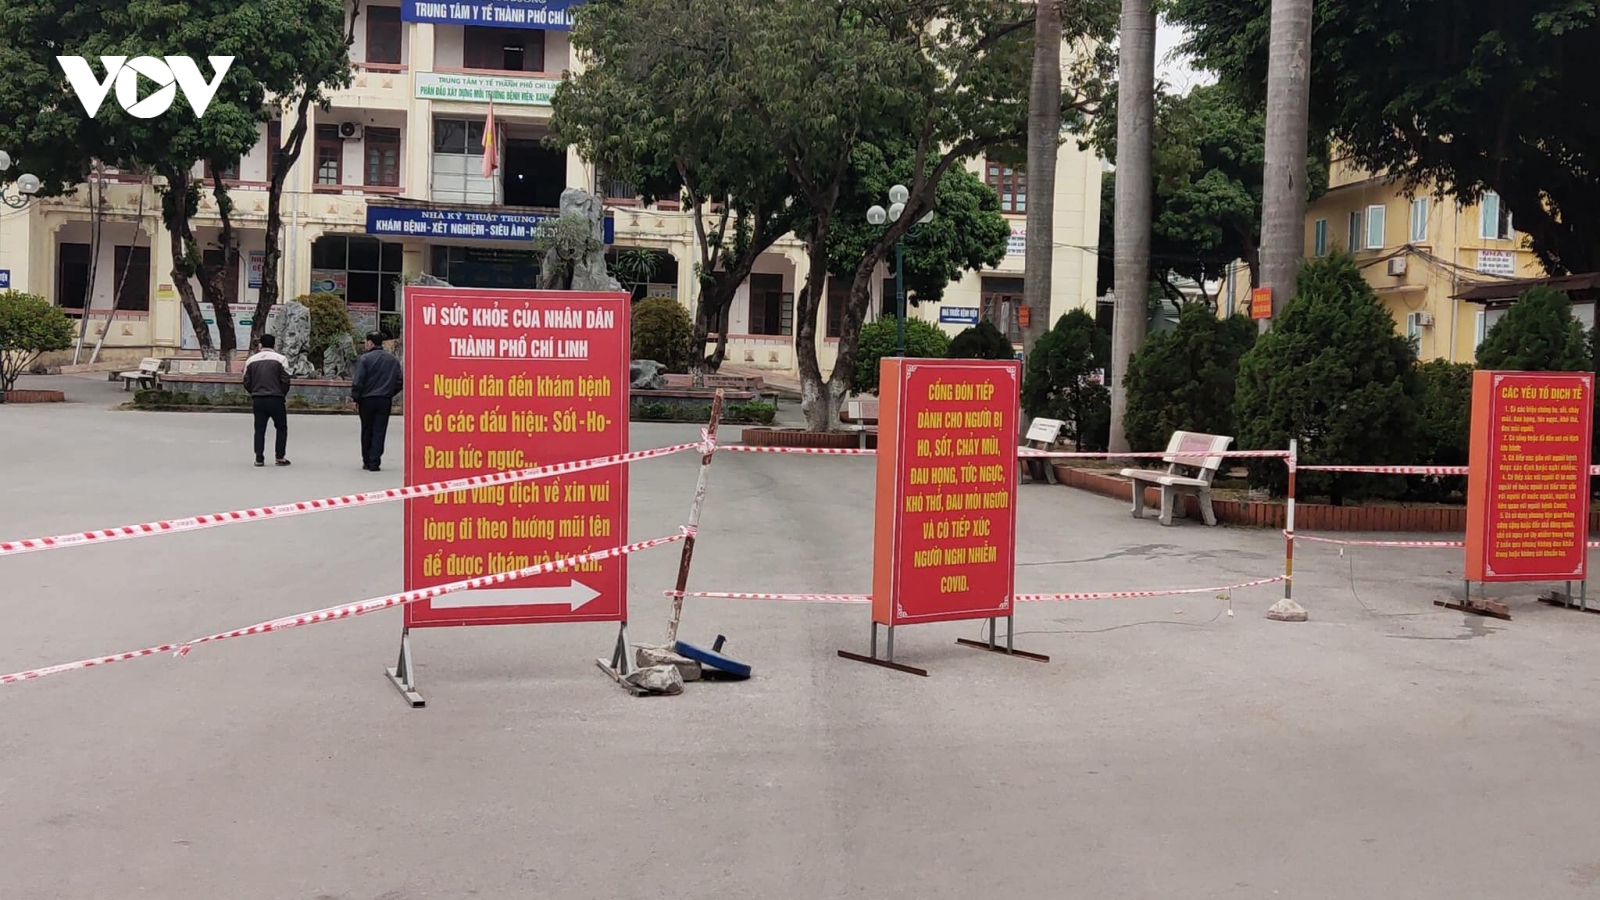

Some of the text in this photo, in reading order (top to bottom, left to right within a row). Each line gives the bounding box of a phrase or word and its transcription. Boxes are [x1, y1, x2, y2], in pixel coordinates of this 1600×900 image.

[415, 2, 447, 18] TRUNG
[450, 3, 470, 20] TÂM
[472, 5, 478, 20] Y
[481, 3, 492, 21] TẾ
[494, 5, 525, 22] THÀNH
[527, 6, 546, 23] PHỐ
[548, 9, 564, 25] CHÍ
[438, 77, 460, 85] TRUNG
[463, 77, 477, 86] TÂM
[479, 78, 484, 86] Y
[486, 78, 493, 86] TẾ
[495, 80, 518, 88] THÀNH
[519, 79, 533, 88] PHỐ
[535, 80, 547, 89] CHÍ
[376, 218, 402, 232] KHÁM
[421, 211, 444, 219] NHÀ
[447, 211, 462, 220] KỸ
[465, 213, 499, 223] THUẬT
[500, 215, 536, 223] TRUNG
[422, 301, 614, 329] VÌ SỨC KHỎE CỦA NHÂN DÂN
[449, 333, 588, 358] THÀNH PHỐ CHÍ LINH
[434, 371, 475, 400] Người
[479, 373, 504, 397] dân
[508, 371, 533, 397] đến
[537, 374, 574, 397] khám
[578, 374, 611, 402] bệnh
[928, 377, 995, 401] CỔNG ĐÓN TIẾP
[1501, 385, 1519, 399] CÁC
[1521, 383, 1537, 399] YẾU
[1539, 383, 1550, 399] TỐ
[1551, 387, 1571, 402] DỊCH
[424, 410, 442, 432] có
[447, 409, 475, 432] các
[479, 405, 507, 432] dấu
[511, 410, 548, 437] hiệu:
[552, 407, 577, 433] Sốt
[917, 407, 1003, 431] DÀNH CHO NGƯỜI BỊ
[424, 446, 455, 469] Đau
[459, 443, 483, 469] tức
[917, 431, 1001, 459] HO, SỐT, CHẢY MŨI,
[910, 461, 1006, 487] ĐAU HỌNG, TỨC NGỰC,
[509, 481, 540, 508] dịch
[543, 476, 561, 503] về
[564, 481, 585, 503] xin
[589, 480, 610, 503] vui
[906, 486, 1008, 513] KHÓ THỞ, ĐAU MỎI NGƯỜI
[424, 514, 611, 543] lòng đi theo hướng mũi tên
[923, 514, 991, 540] VÀ CÓ TIẾP XÚC
[424, 549, 442, 577] để
[447, 553, 484, 580] được
[488, 552, 529, 576] khám
[914, 540, 998, 568] NGƯỜI NGHI NHIỄM
[940, 575, 970, 593] COVID.
